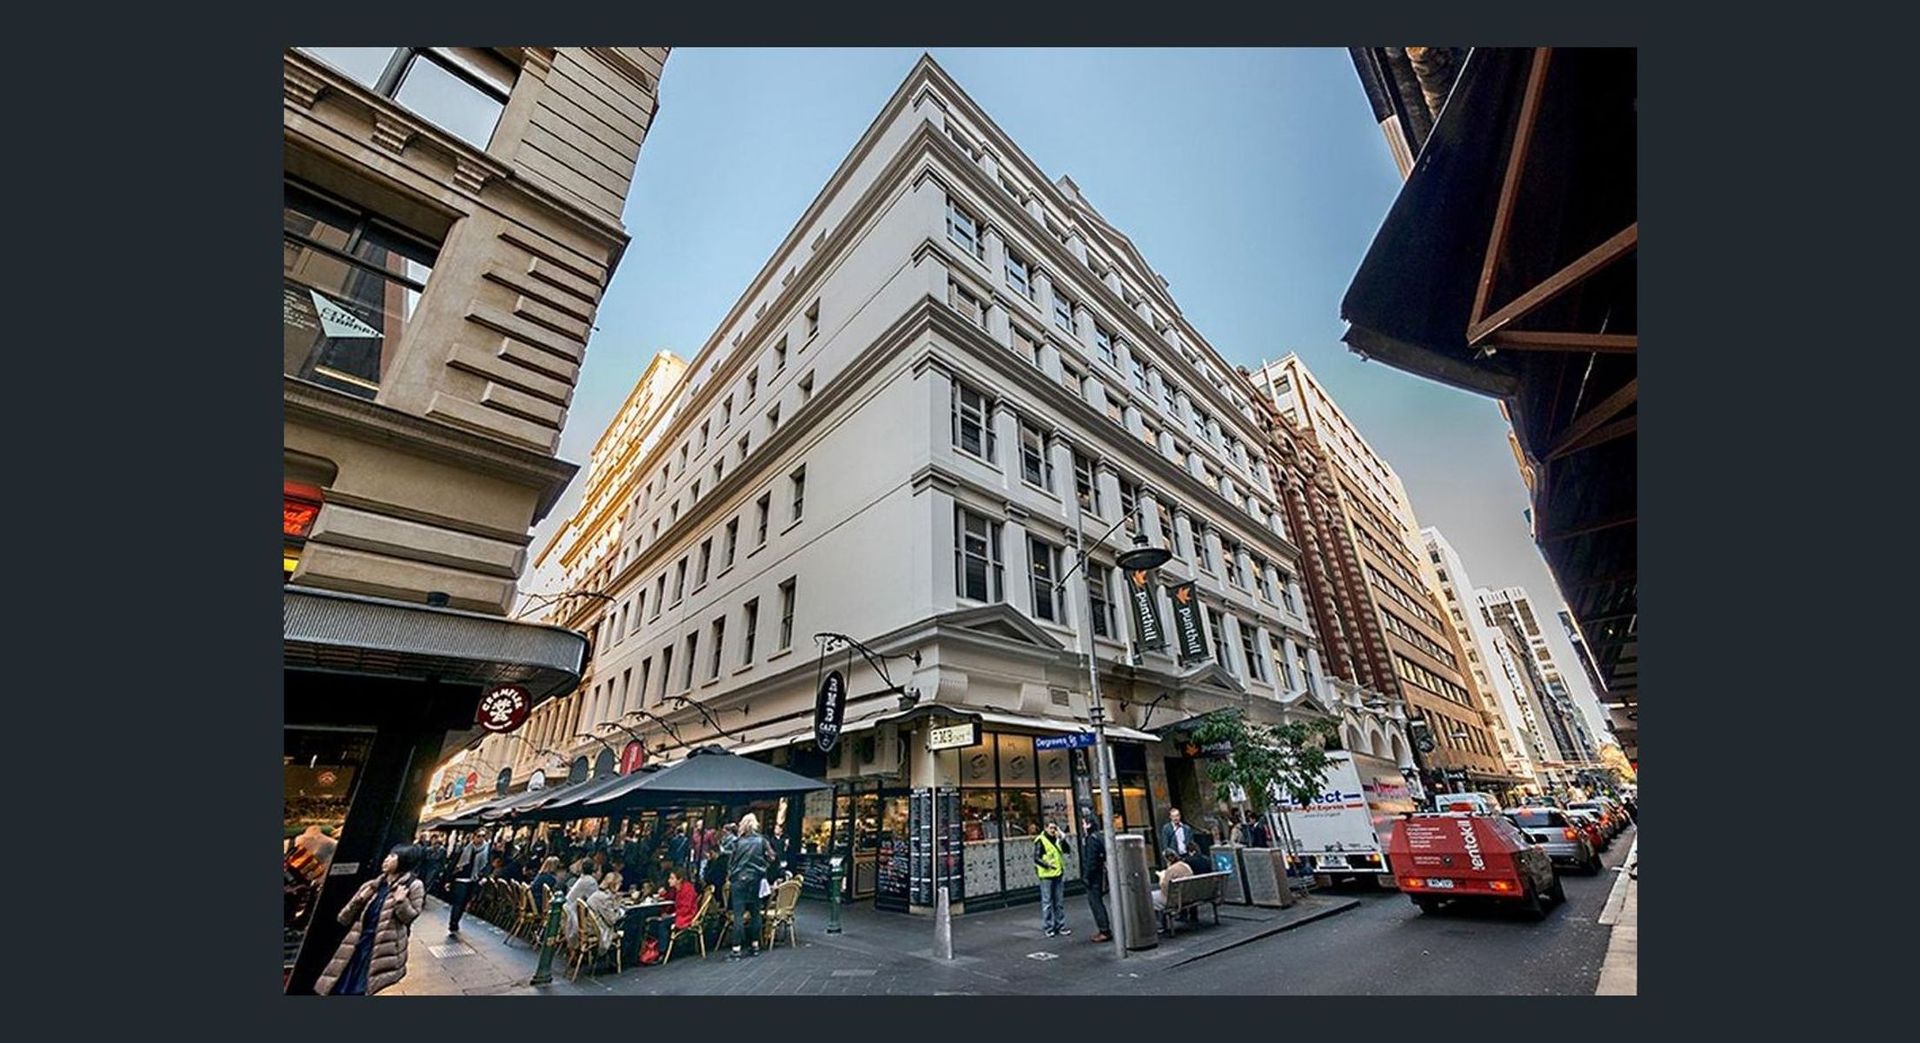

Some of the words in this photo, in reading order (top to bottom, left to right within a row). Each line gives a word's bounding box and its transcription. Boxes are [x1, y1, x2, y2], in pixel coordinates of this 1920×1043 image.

[1135, 591, 1158, 641] punthill
[1179, 607, 1202, 655] punthill
[1290, 790, 1342, 805] Dect
